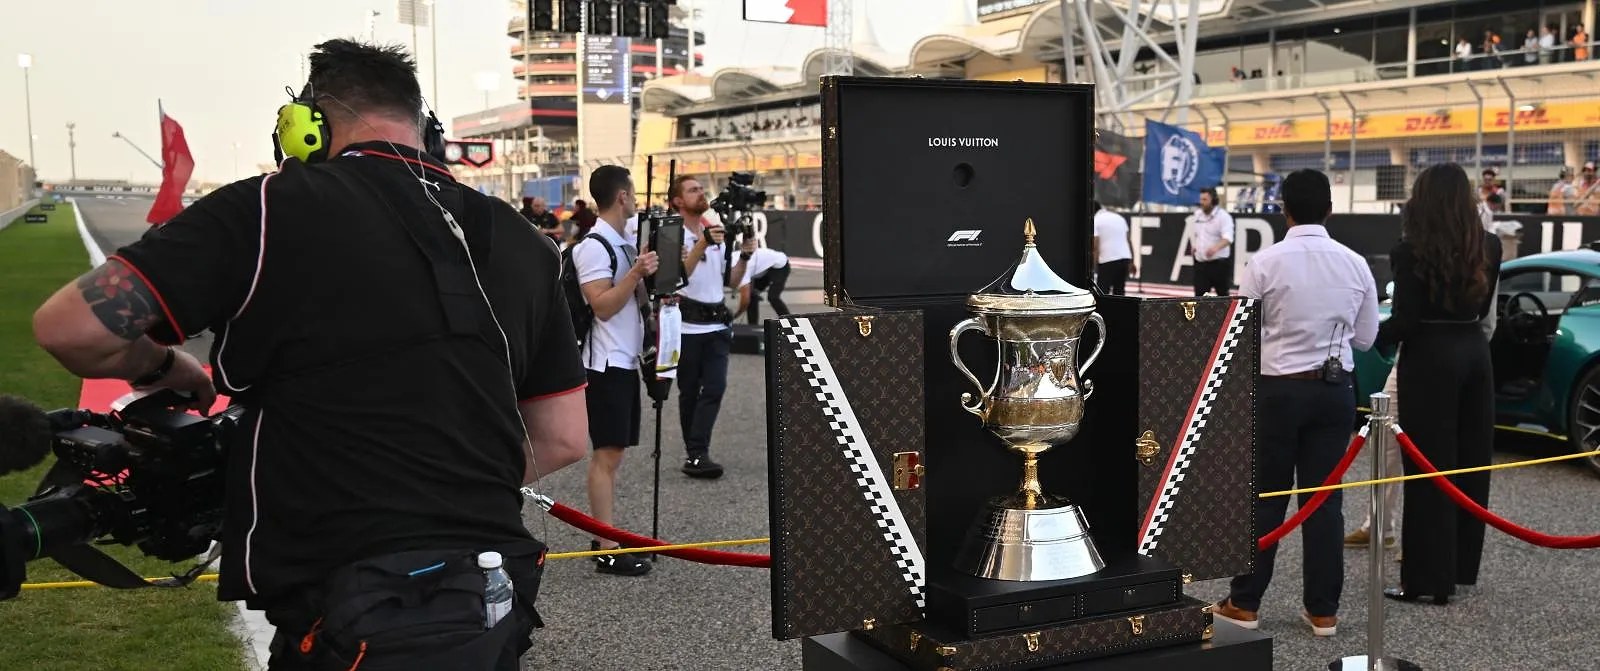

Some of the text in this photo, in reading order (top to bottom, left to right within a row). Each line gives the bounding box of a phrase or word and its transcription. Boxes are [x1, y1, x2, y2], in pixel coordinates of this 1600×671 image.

[1404, 115, 1452, 131] DHL
[1495, 108, 1549, 127] DHL
[1255, 124, 1292, 140] DHL
[1328, 119, 1368, 136] DHL
[928, 137, 999, 147] LOUIS VUITTON
[947, 229, 982, 242] F1
